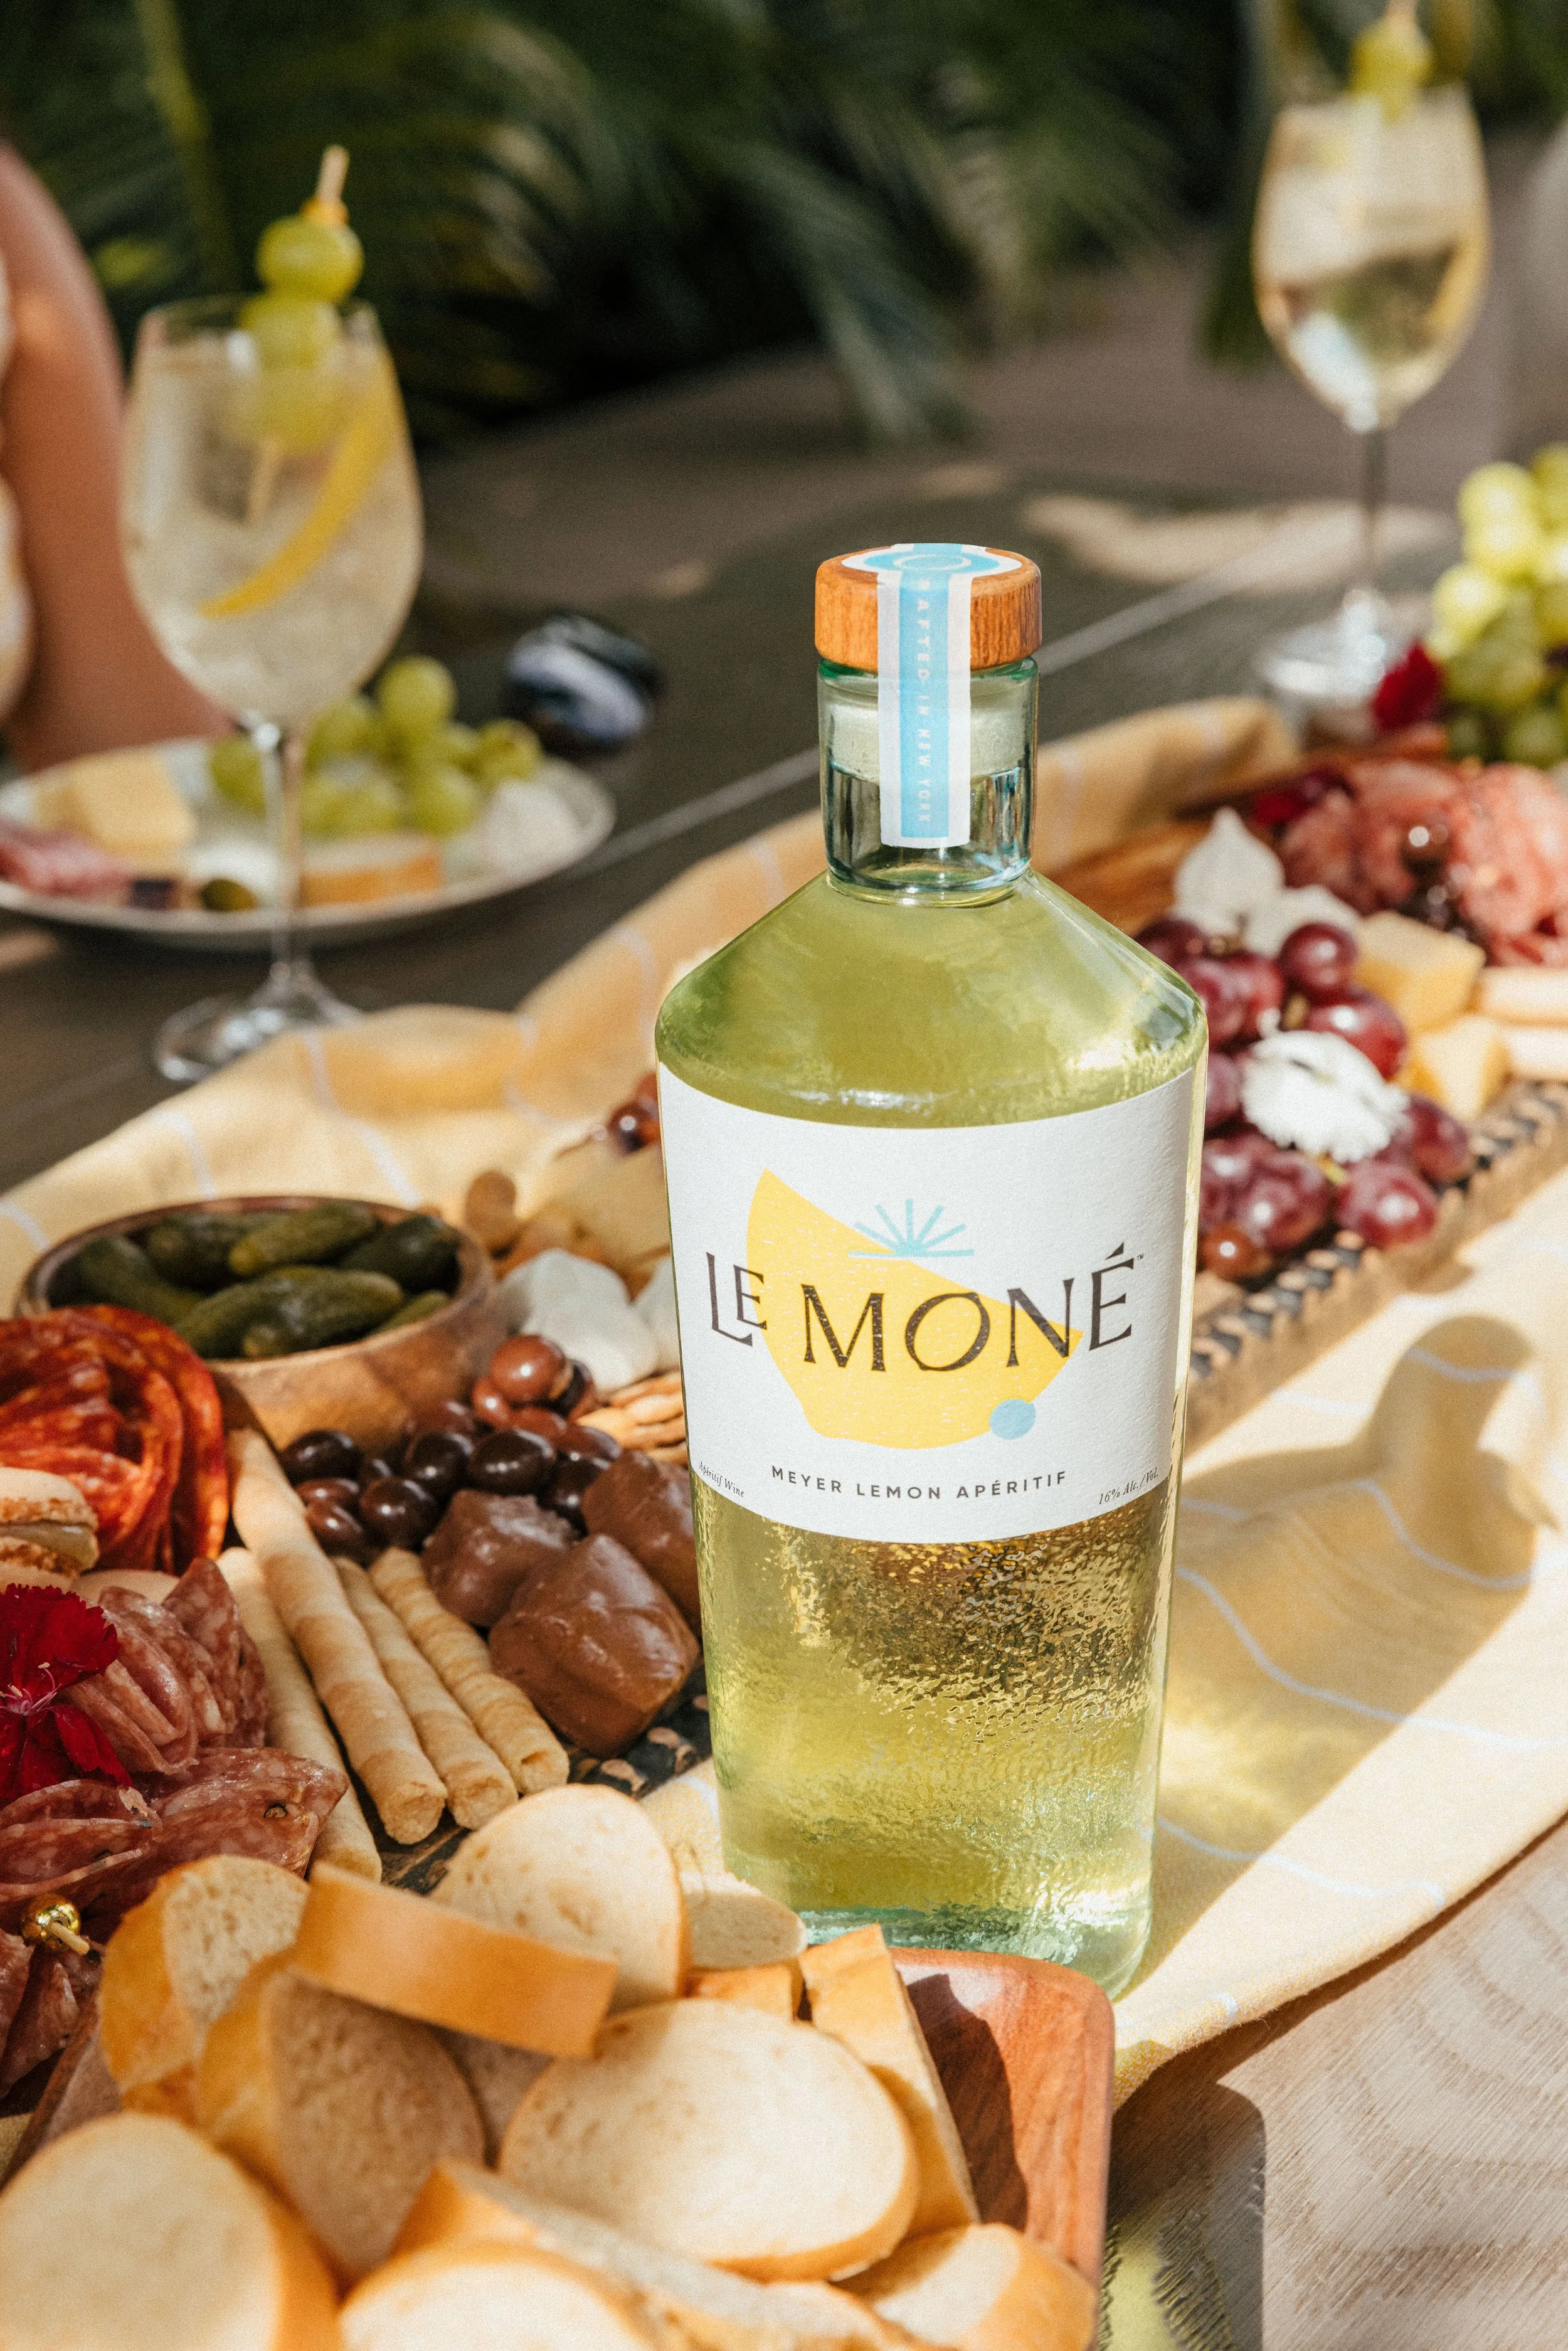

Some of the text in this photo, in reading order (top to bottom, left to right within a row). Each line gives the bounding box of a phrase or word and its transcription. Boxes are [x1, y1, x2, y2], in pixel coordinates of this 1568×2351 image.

[918, 694, 930, 715] IN
[918, 728, 931, 767] NEW
[918, 779, 931, 823] YORK
[699, 1461, 744, 1497] Apéritif Wine
[771, 1466, 1066, 1499] MEYER LEMON APÉRITIF
[1099, 1487, 1120, 1505] 16%
